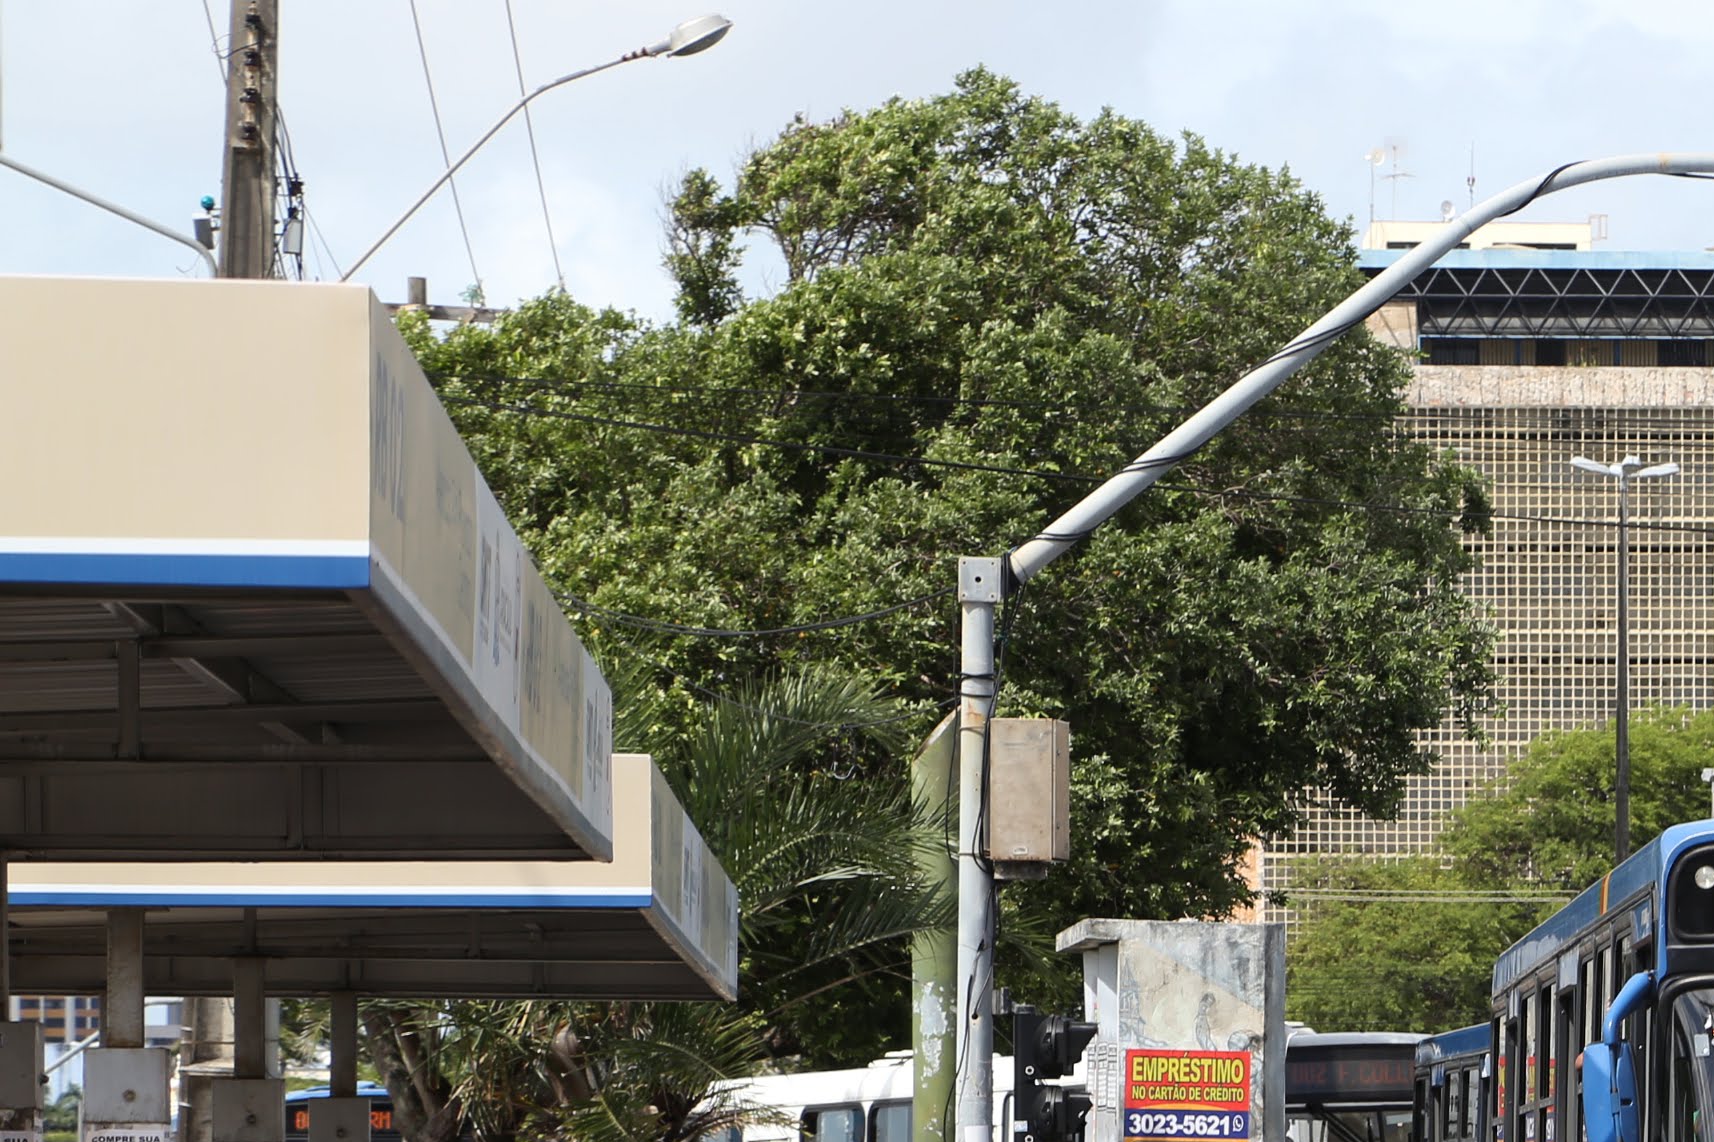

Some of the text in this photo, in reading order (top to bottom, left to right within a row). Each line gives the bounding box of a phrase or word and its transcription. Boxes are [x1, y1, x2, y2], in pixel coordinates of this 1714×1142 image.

[1132, 1052, 1245, 1084] EMPRÉSTIMO
[1131, 1084, 1245, 1102] NO CARTÃO DE CRÉDITO
[1128, 1113, 1230, 1136] 3023-5621
